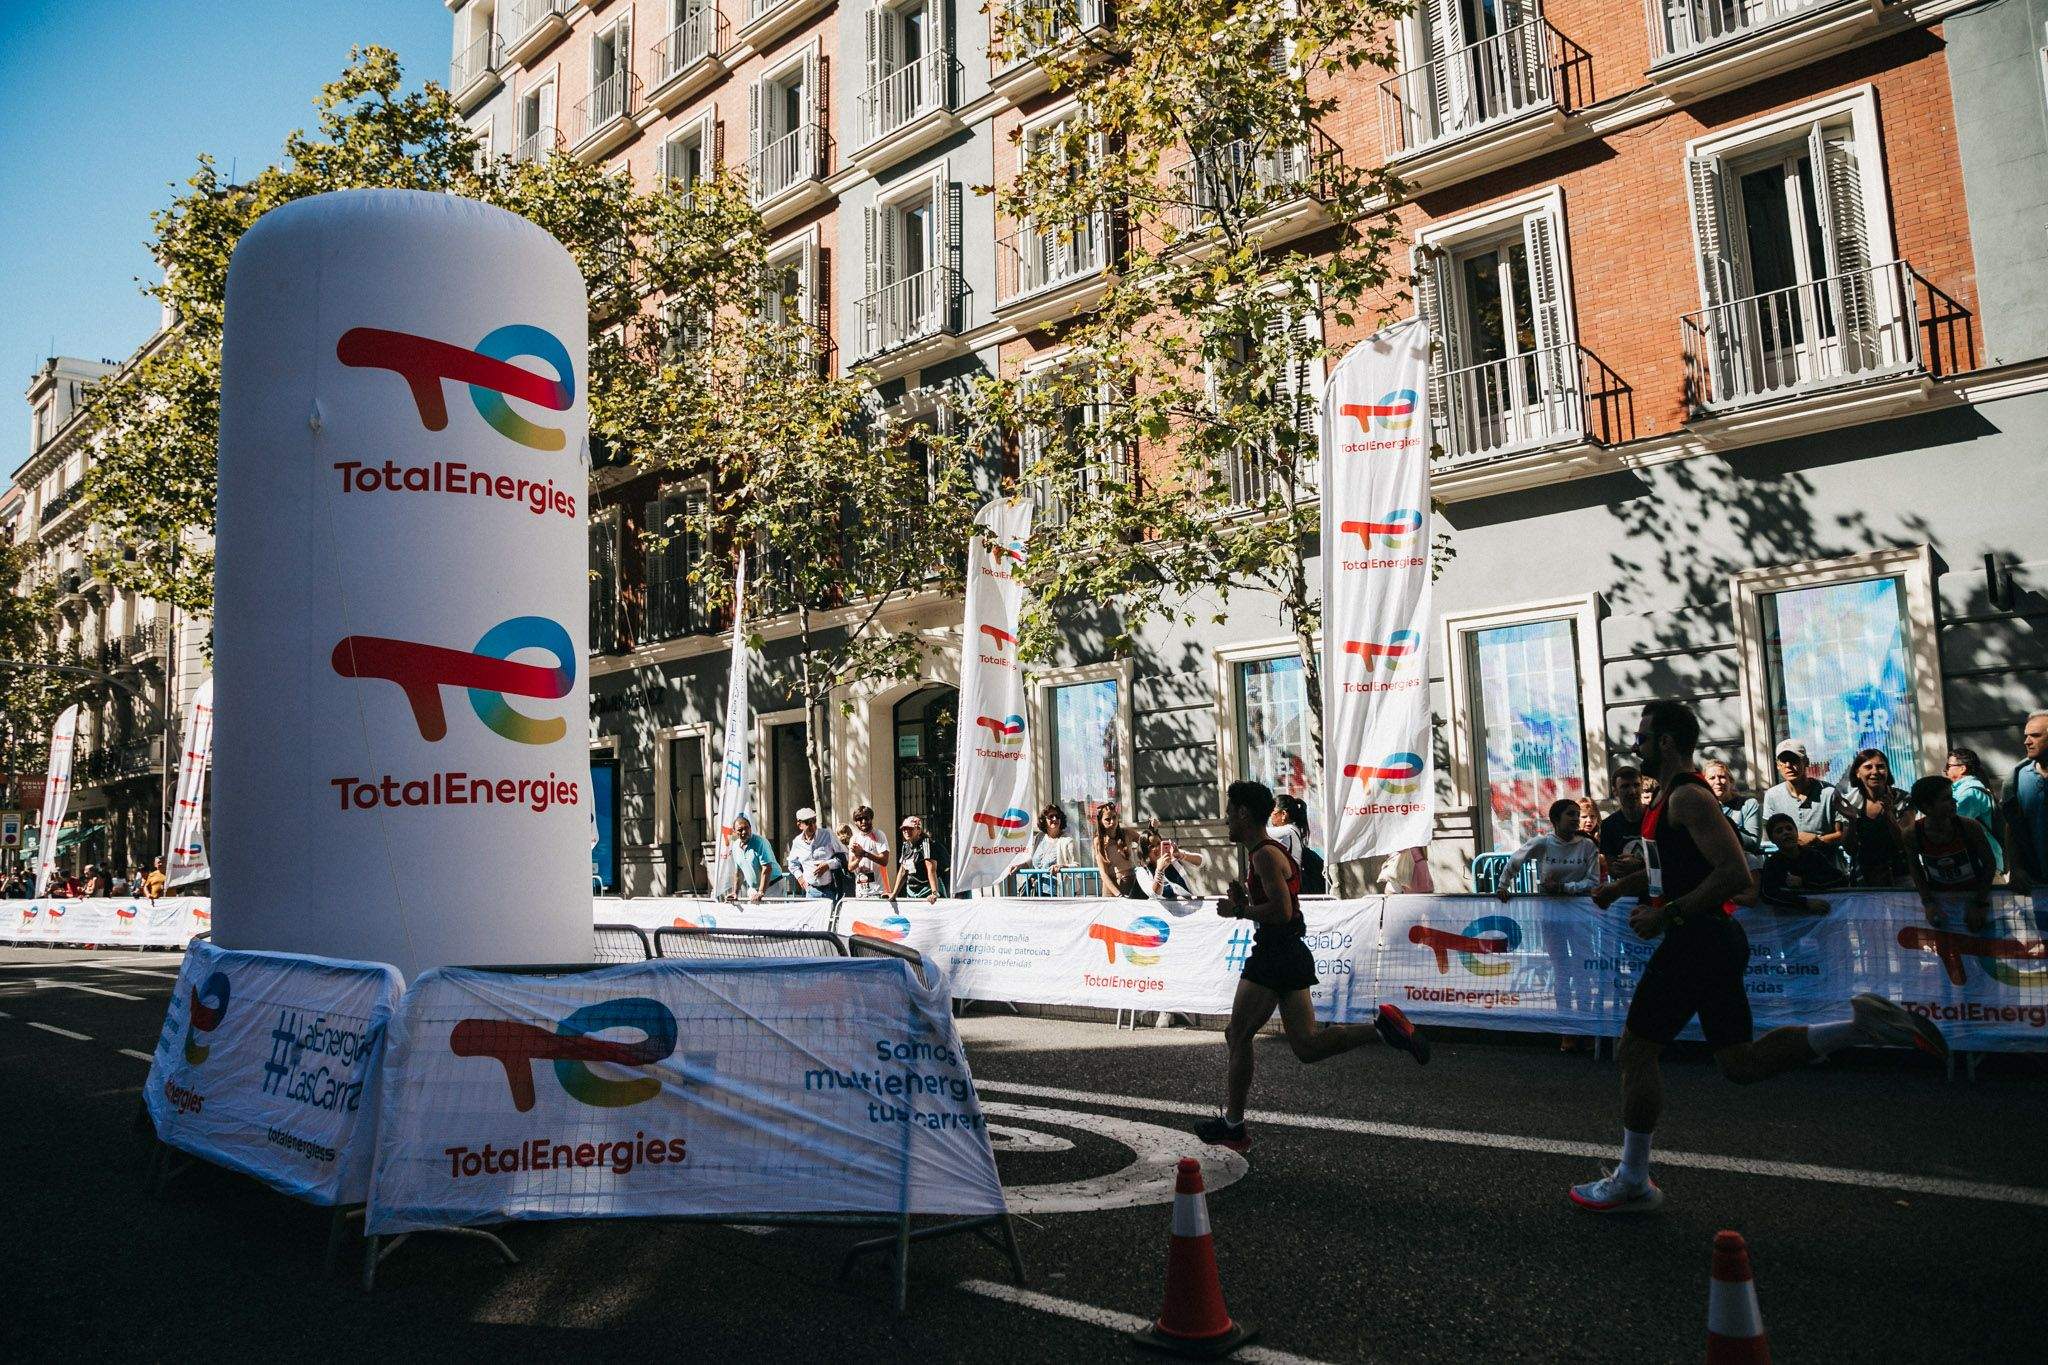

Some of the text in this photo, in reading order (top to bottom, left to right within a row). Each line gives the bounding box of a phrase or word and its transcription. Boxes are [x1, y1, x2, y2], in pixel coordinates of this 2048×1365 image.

[1340, 436, 1421, 454] TotalEnergies
[333, 459, 576, 518] TotalEnergies
[1342, 555, 1424, 571] TotalEnergies
[1343, 677, 1420, 693] TotalEnergies
[331, 771, 578, 812] TotalEnergies
[1344, 801, 1425, 817] TotalEnergies
[1083, 974, 1164, 993] TotalEnergies
[1404, 985, 1520, 1009] TotalEnergies
[445, 1131, 686, 1178] TotalEnergies
